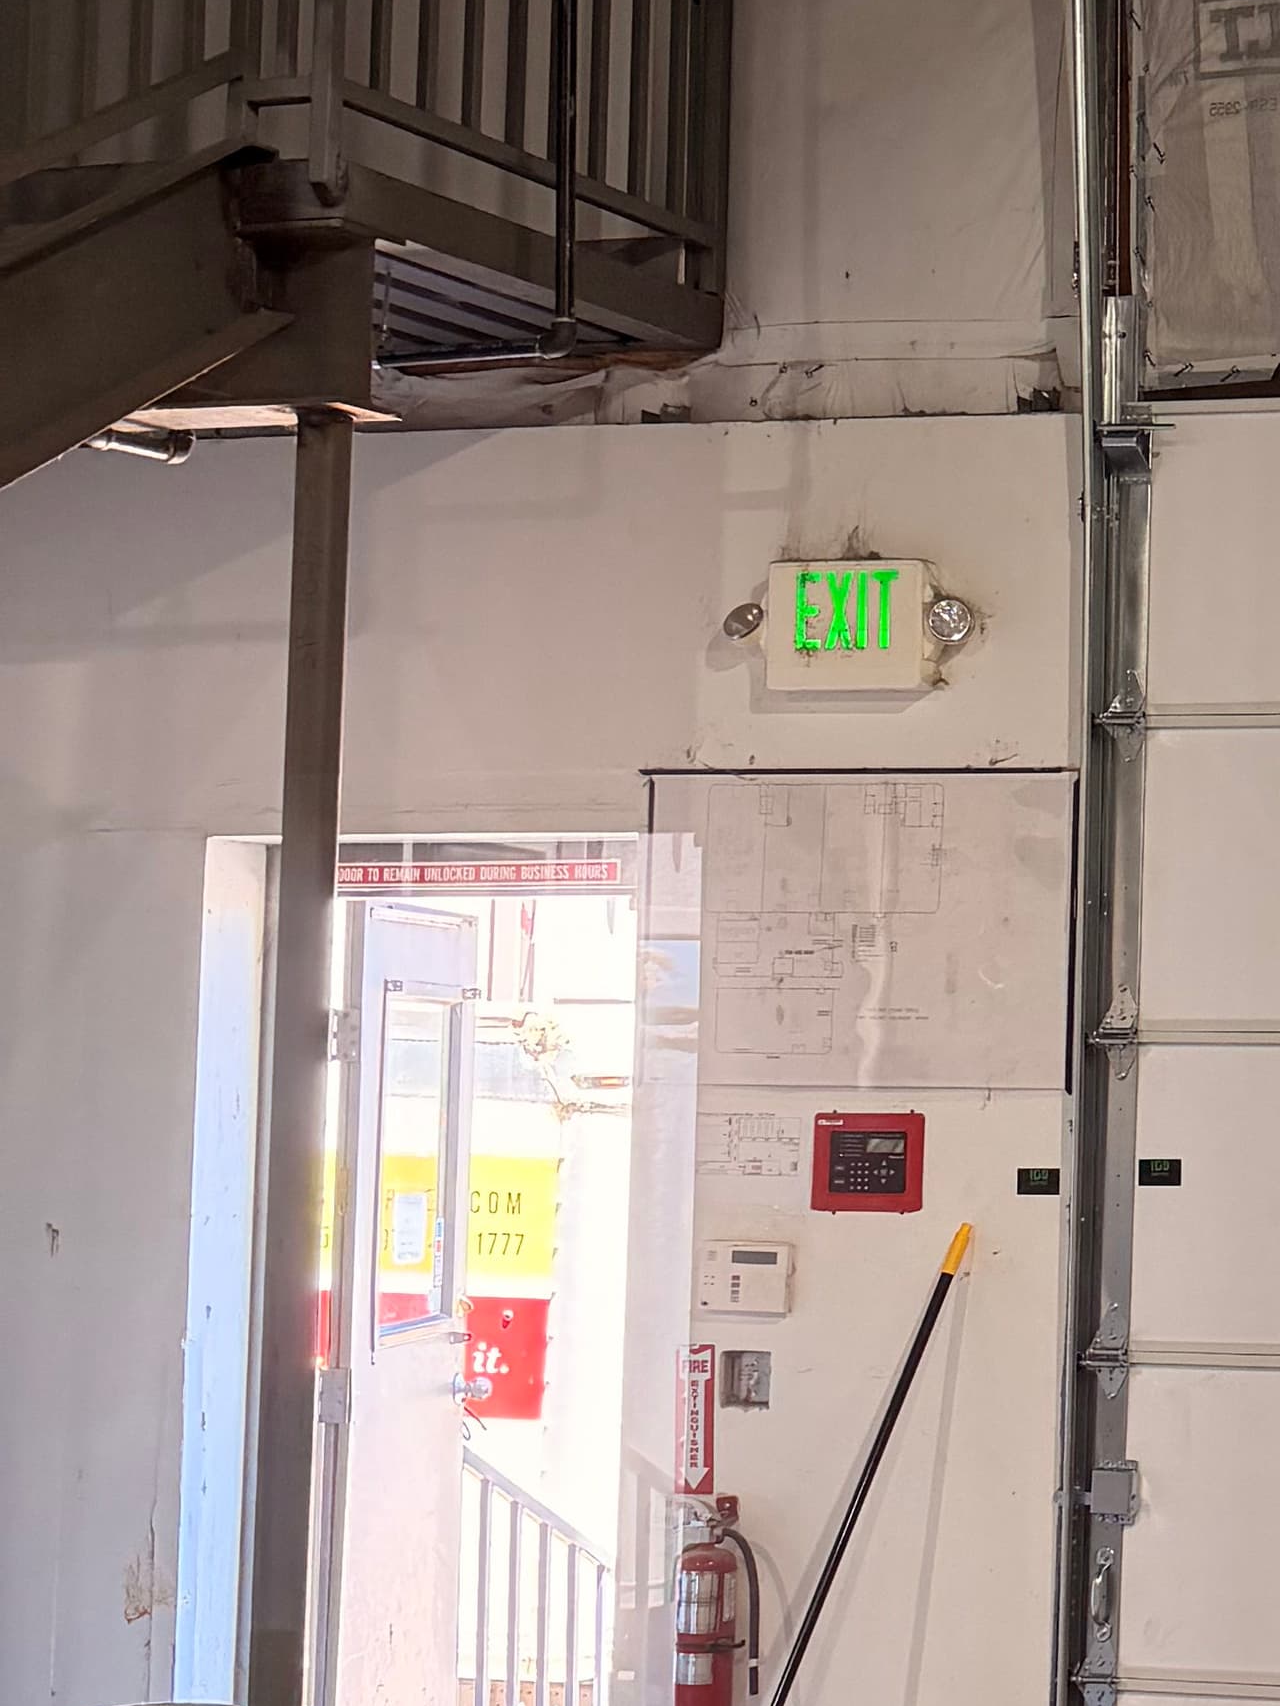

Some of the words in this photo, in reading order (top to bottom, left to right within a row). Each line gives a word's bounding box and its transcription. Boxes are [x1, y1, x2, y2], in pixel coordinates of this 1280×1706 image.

[795, 569, 898, 654] EXIT
[367, 864, 380, 882] TO
[383, 864, 421, 882] REMAIN
[424, 864, 476, 882] UNLOCKED
[480, 864, 516, 881] DURING
[520, 863, 570, 881] BUSINESS
[574, 863, 609, 880] HOURS
[477, 1232, 525, 1256] 1777
[472, 1341, 510, 1374] it.
[682, 1359, 709, 1374] FIRE
[689, 1379, 699, 1469] EXTINGUISHER
